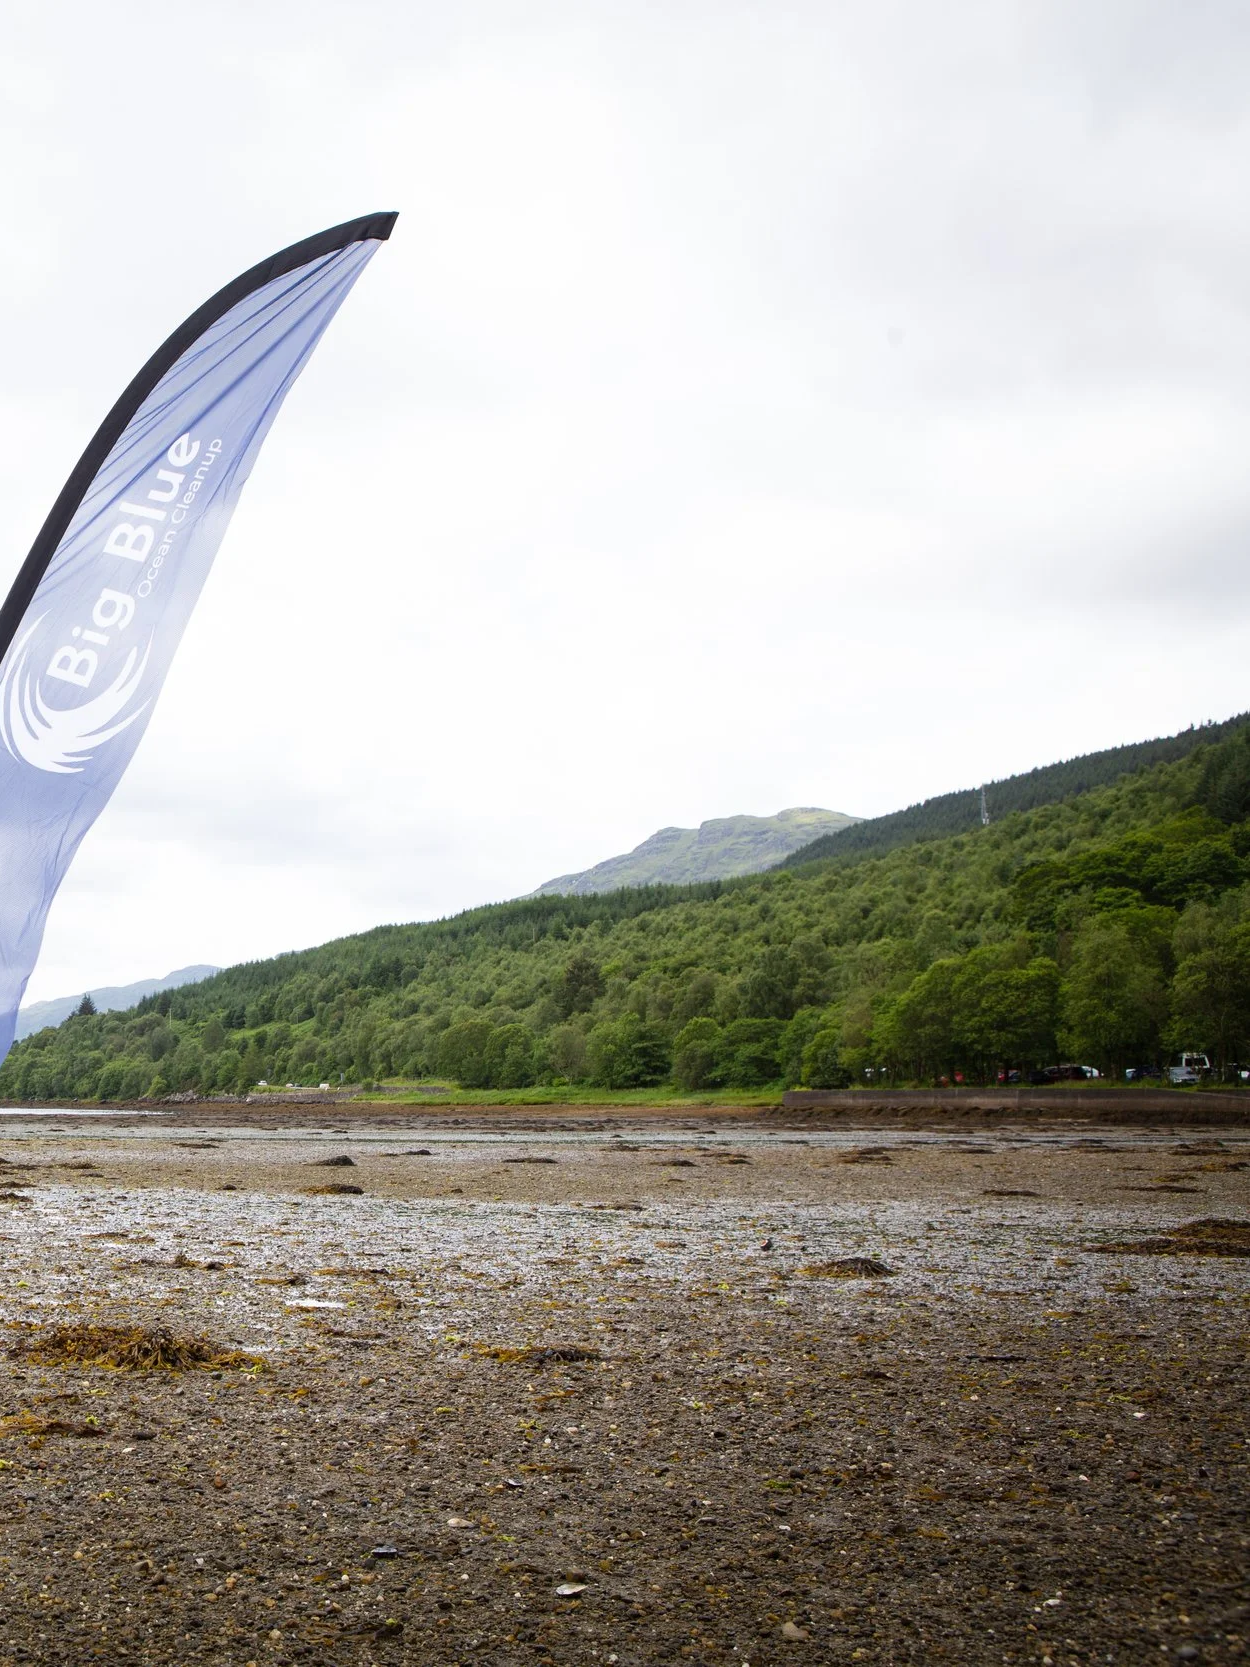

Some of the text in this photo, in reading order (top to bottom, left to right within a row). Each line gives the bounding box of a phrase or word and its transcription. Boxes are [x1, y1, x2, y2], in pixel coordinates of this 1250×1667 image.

[45, 432, 201, 689] Big Blue
[137, 437, 223, 598] Ocean Cleanup
